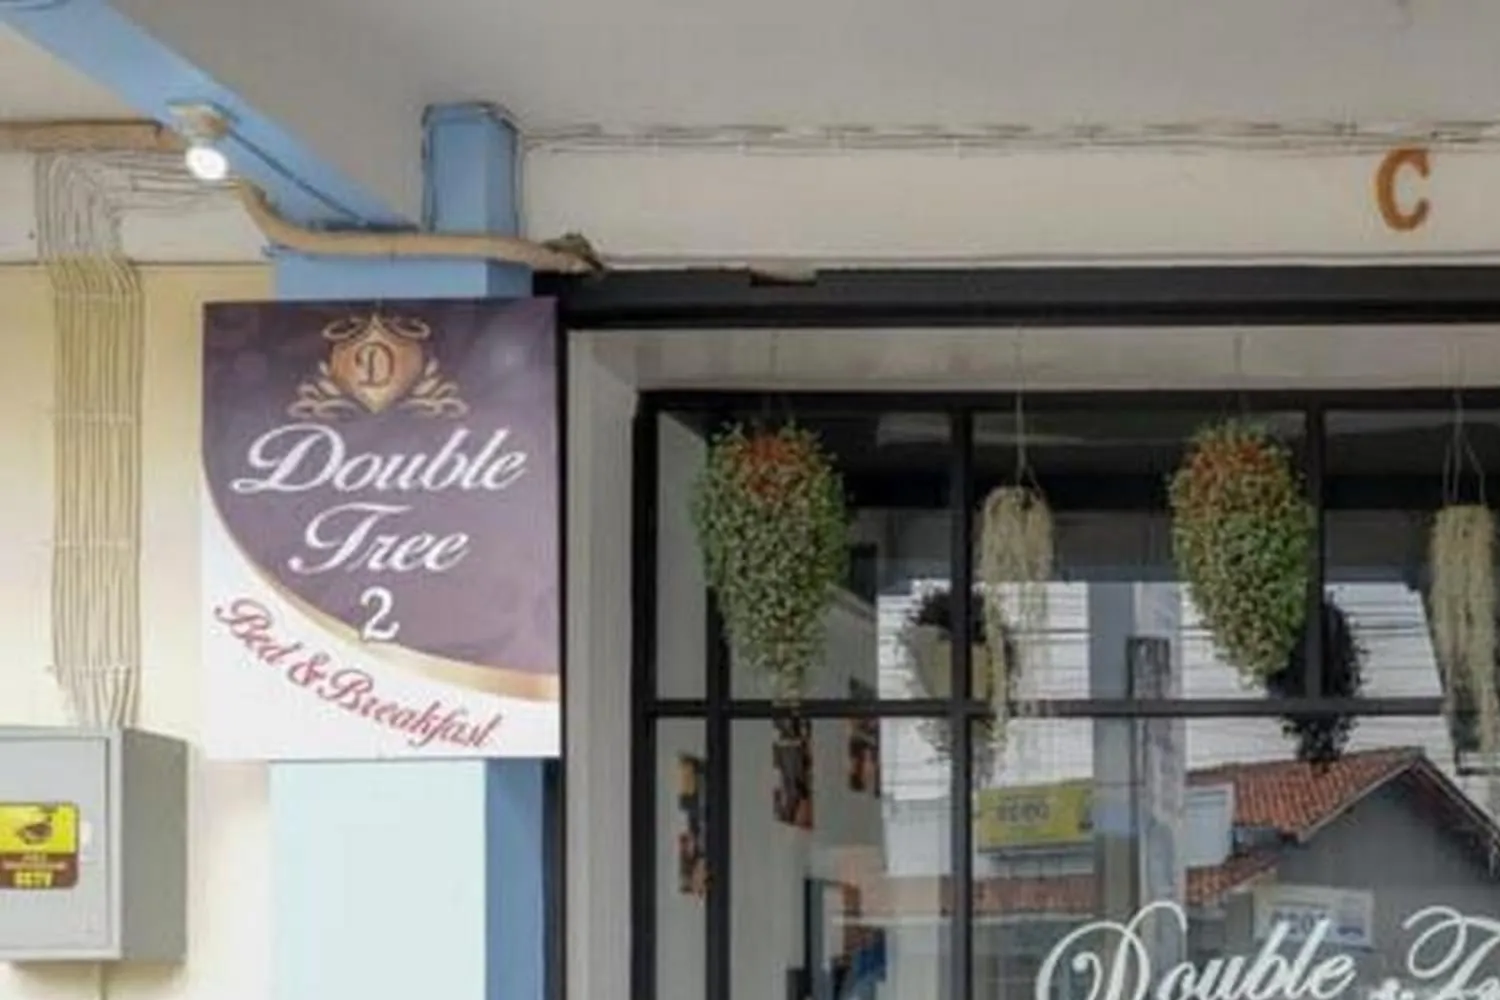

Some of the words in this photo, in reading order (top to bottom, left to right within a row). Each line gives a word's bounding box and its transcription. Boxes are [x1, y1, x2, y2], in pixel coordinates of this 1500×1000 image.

[1377, 148, 1430, 231] C
[354, 341, 397, 387] D
[230, 423, 528, 494] Double
[288, 503, 471, 574] Tree
[214, 598, 302, 667] Bed
[360, 587, 399, 640] 2
